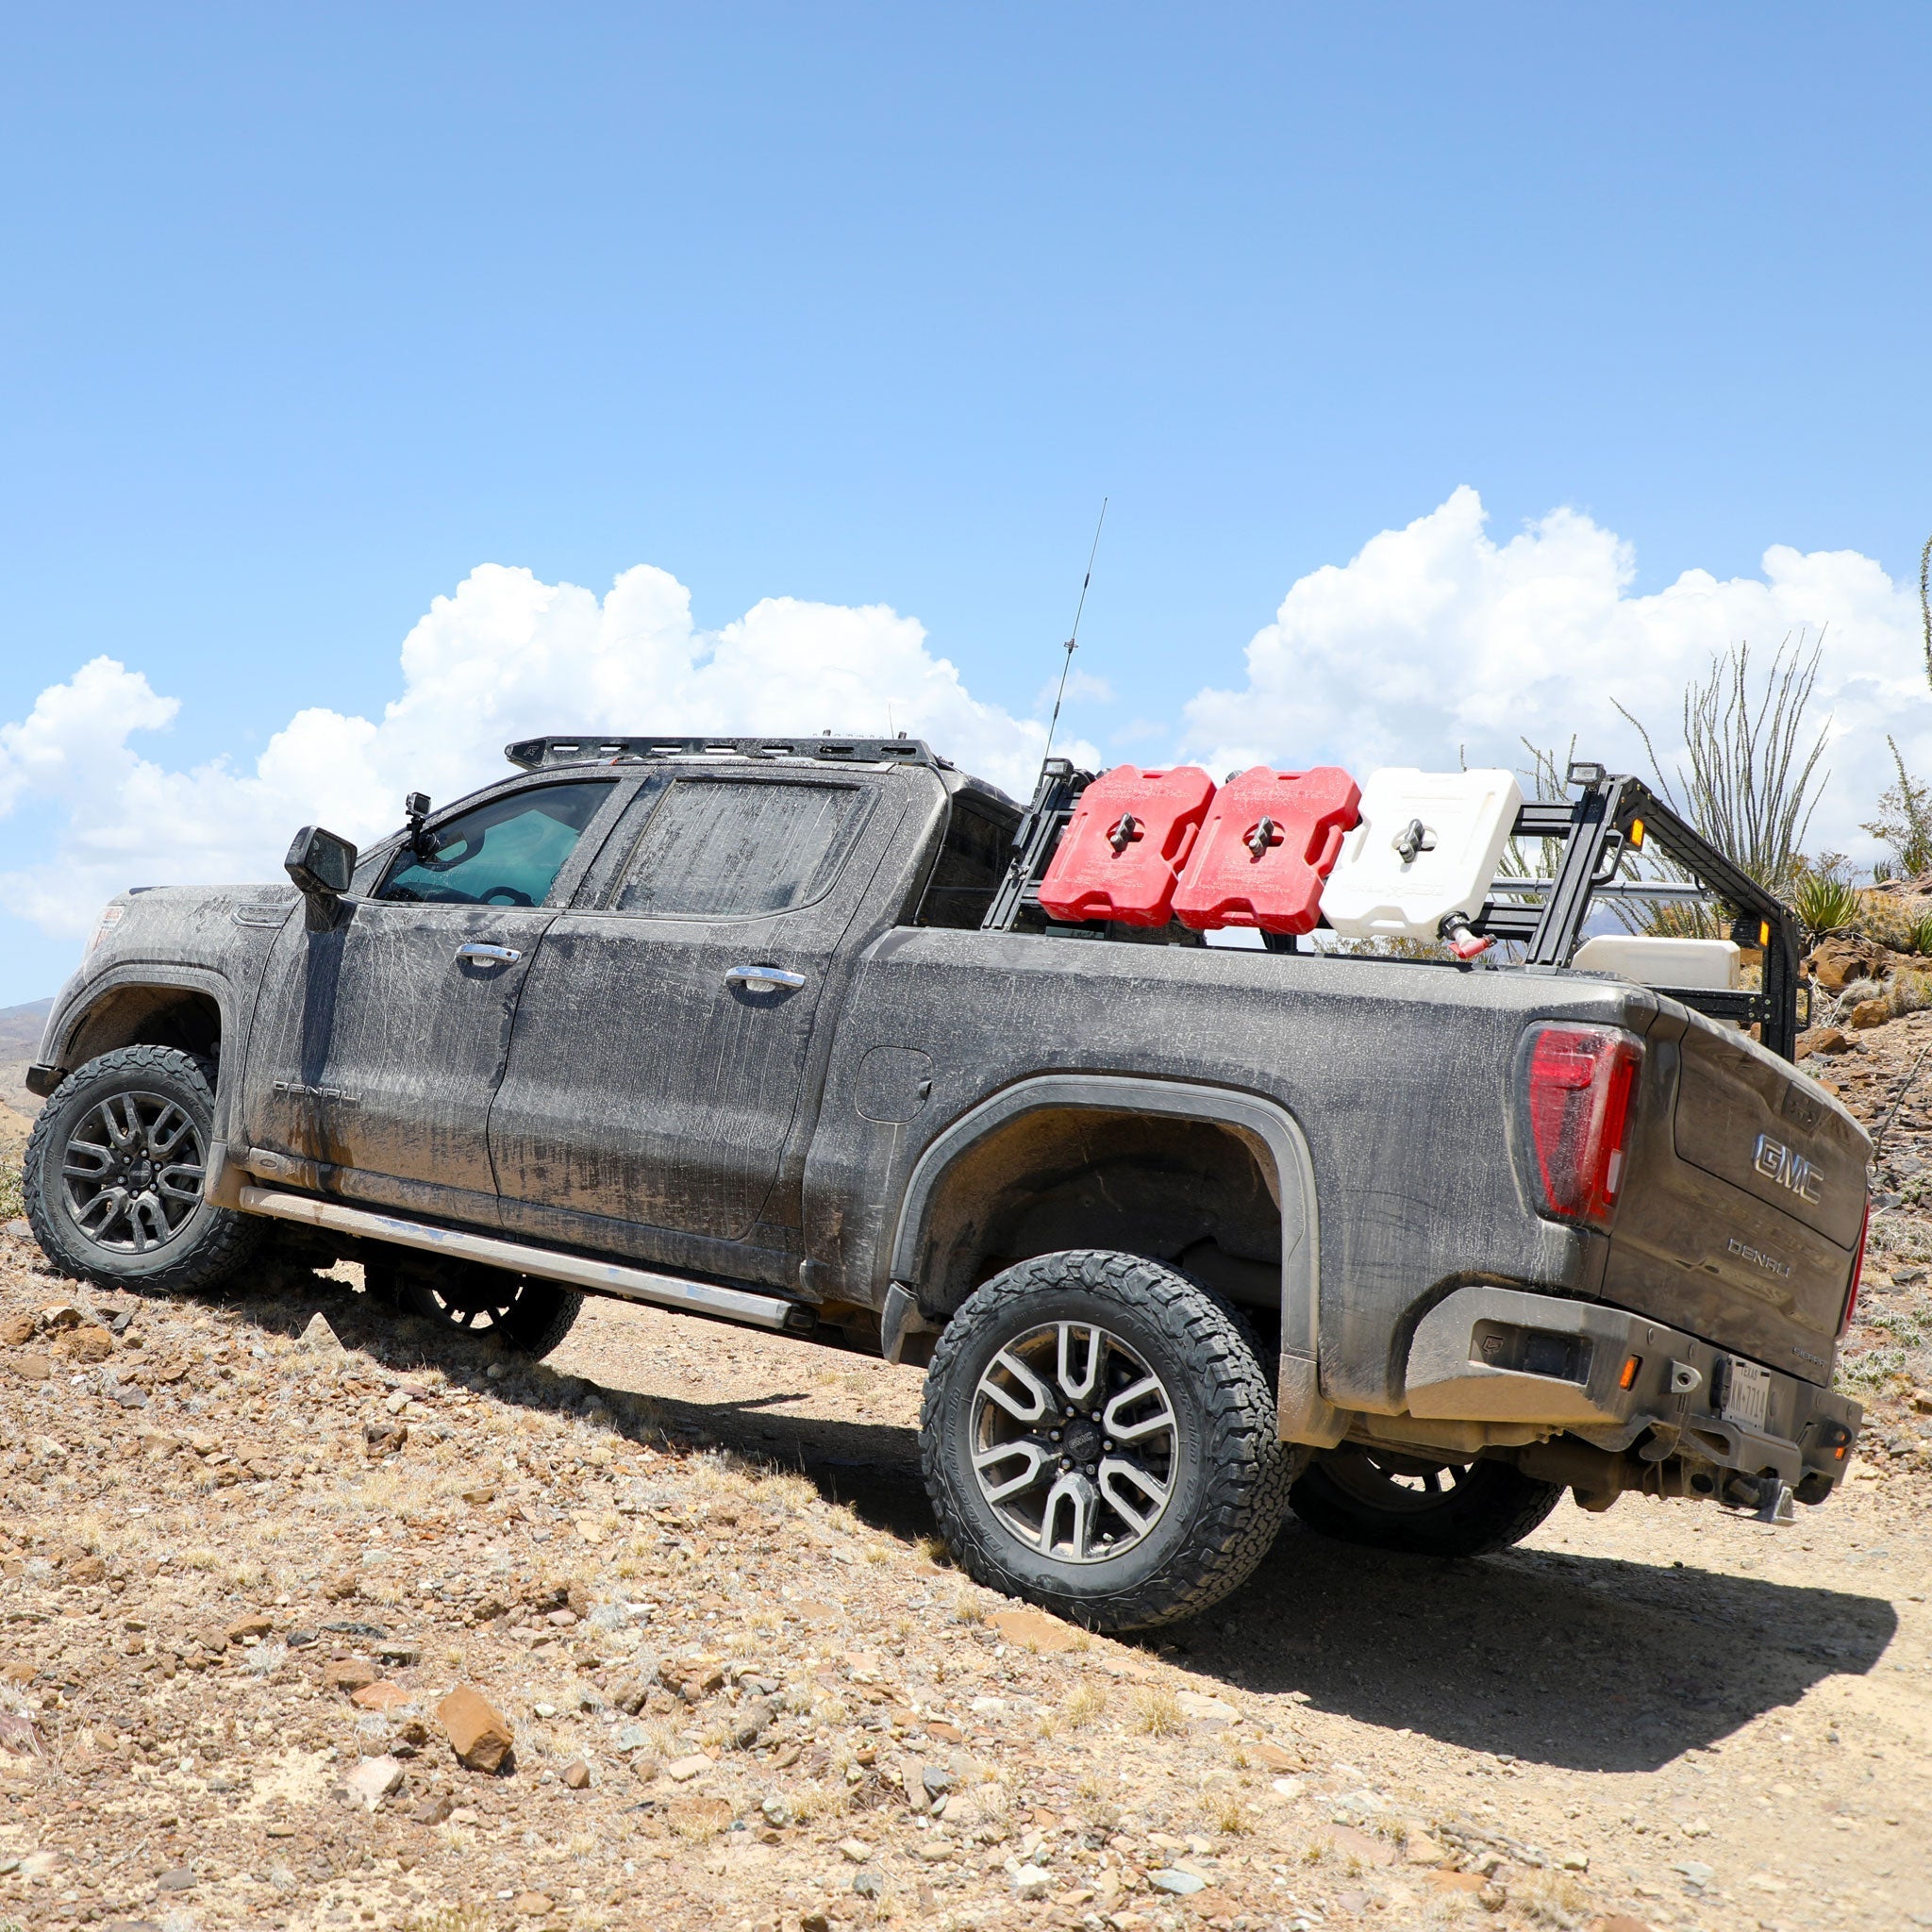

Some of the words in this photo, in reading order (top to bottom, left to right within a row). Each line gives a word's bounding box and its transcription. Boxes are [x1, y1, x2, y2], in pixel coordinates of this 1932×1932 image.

[273, 1080, 361, 1102] DENALI
[1752, 1134, 1824, 1205] GMC
[1727, 1238, 1790, 1278] DENALI
[1740, 1366, 1758, 1381] TEXAS
[1068, 1431, 1094, 1449] GMC
